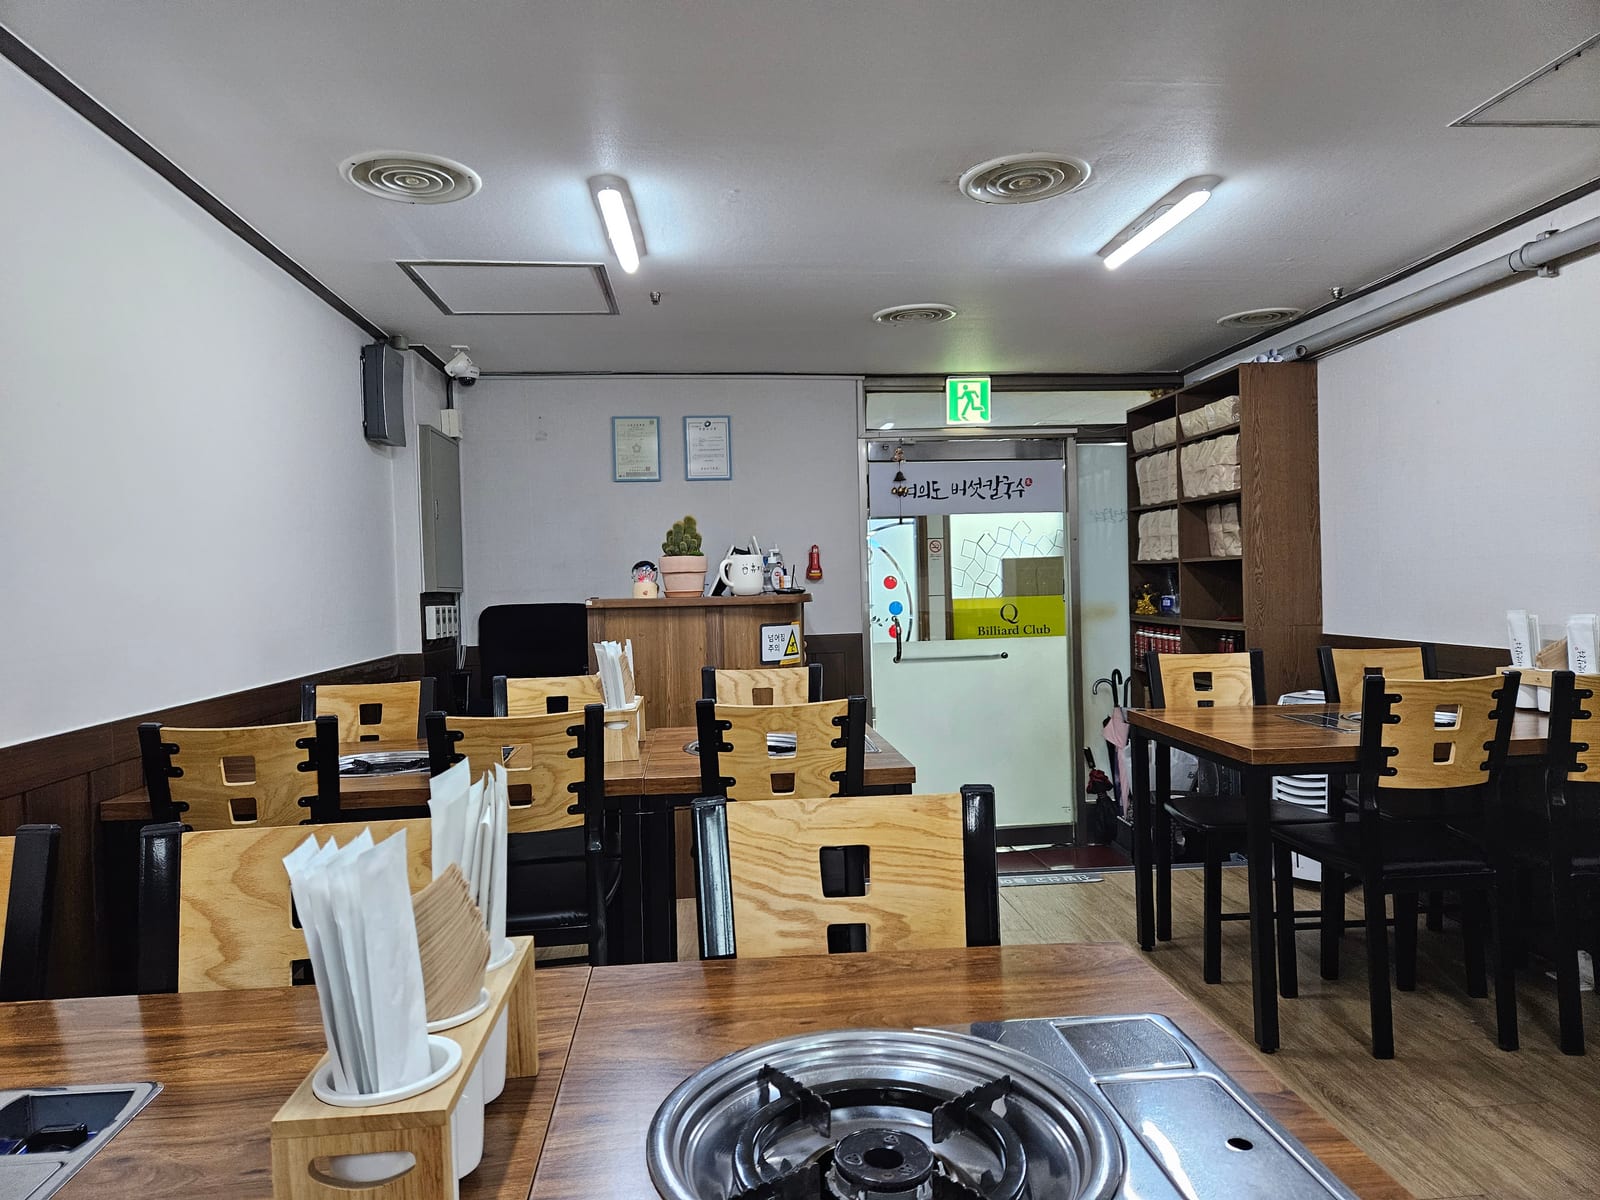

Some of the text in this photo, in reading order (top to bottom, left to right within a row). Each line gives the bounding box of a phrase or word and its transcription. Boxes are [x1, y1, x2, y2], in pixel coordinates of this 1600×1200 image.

[951, 475, 1026, 500] 버섯칼국수
[1000, 603, 1019, 624] Q
[977, 623, 1051, 636] Billiard Club
[768, 633, 786, 643] 넘어짐
[768, 644, 781, 653] 주의
